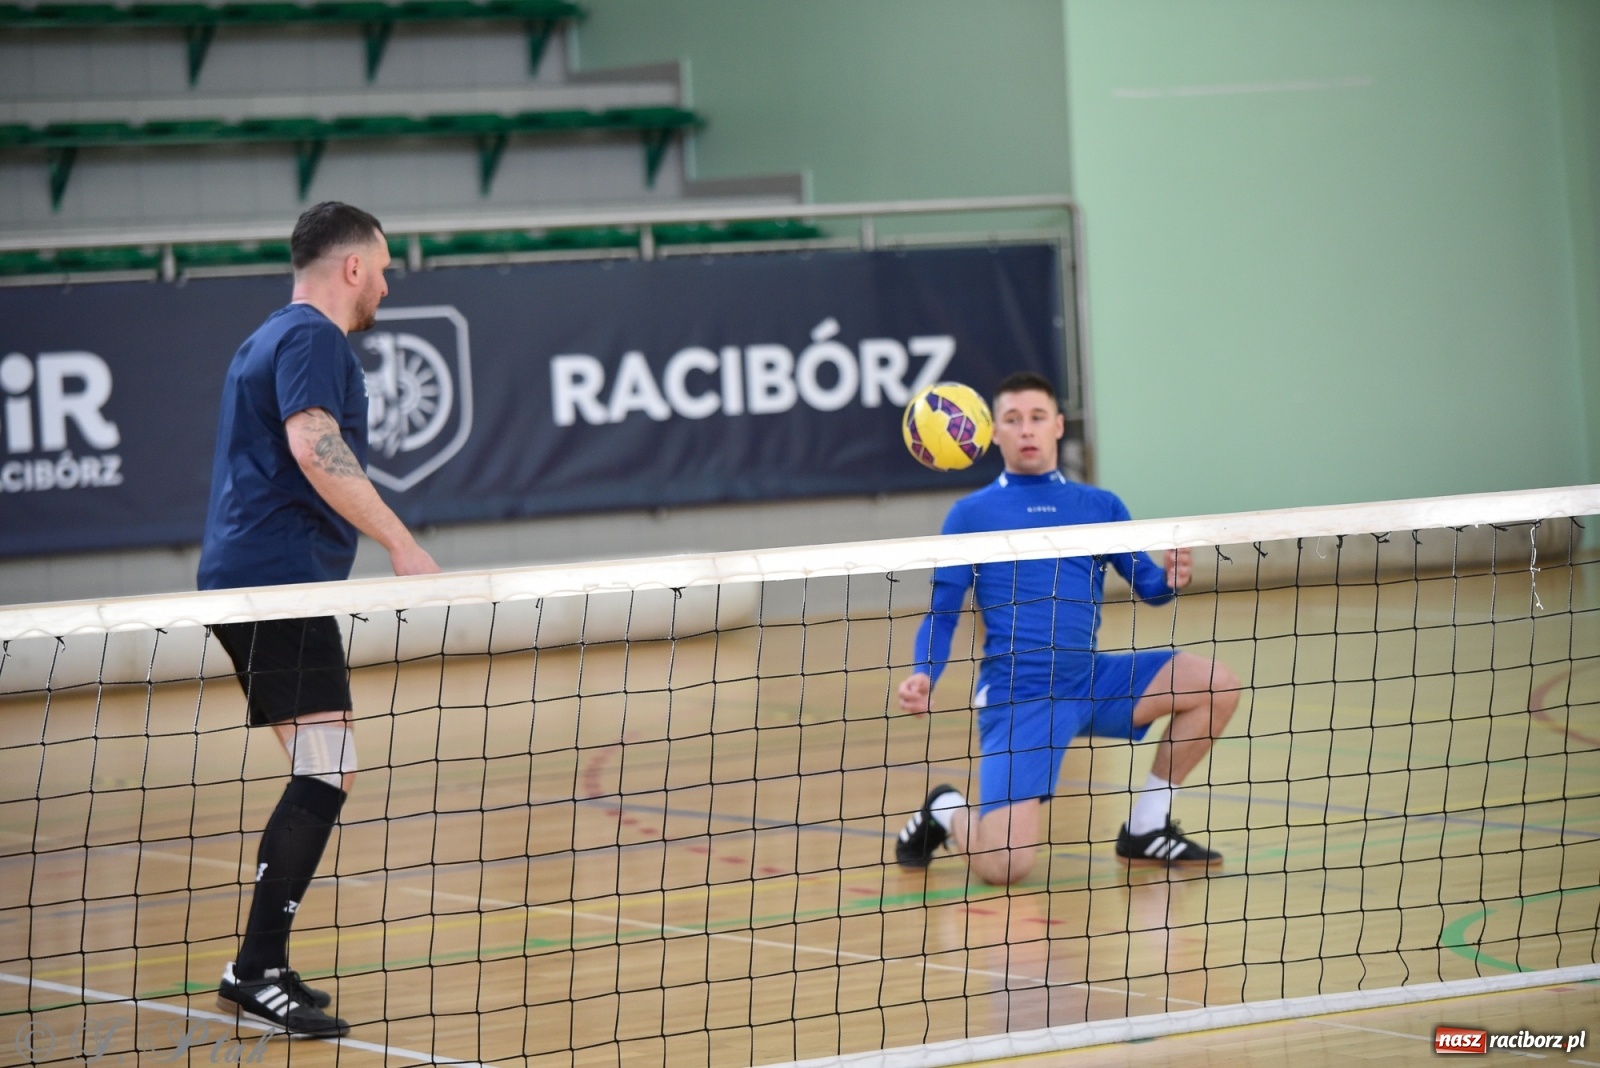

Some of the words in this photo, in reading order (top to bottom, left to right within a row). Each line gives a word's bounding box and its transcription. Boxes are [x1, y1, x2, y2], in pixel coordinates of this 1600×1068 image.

[0, 351, 120, 453] iR
[551, 317, 956, 426] RACIBÓRZ
[0, 449, 124, 492] CIBÓRZ
